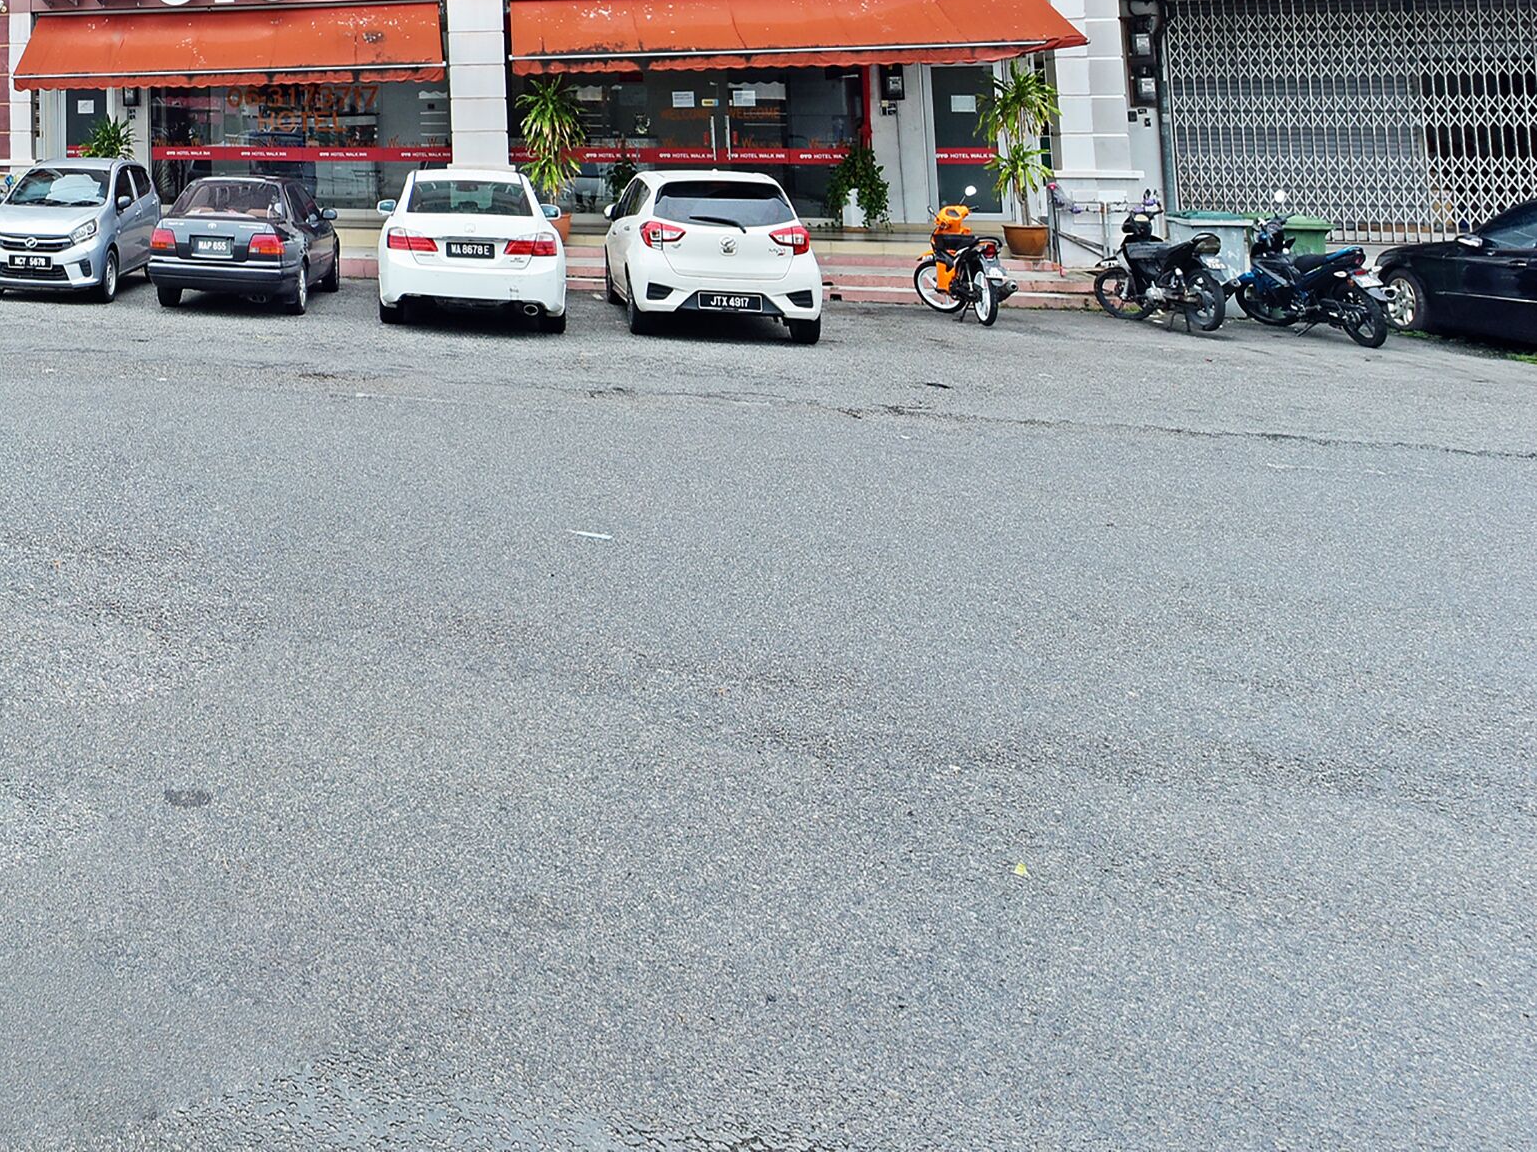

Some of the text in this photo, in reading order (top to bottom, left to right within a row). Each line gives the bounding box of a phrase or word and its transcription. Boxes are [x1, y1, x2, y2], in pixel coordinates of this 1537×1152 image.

[257, 110, 348, 133] HOTEL
[710, 296, 750, 308] JTX 4917
